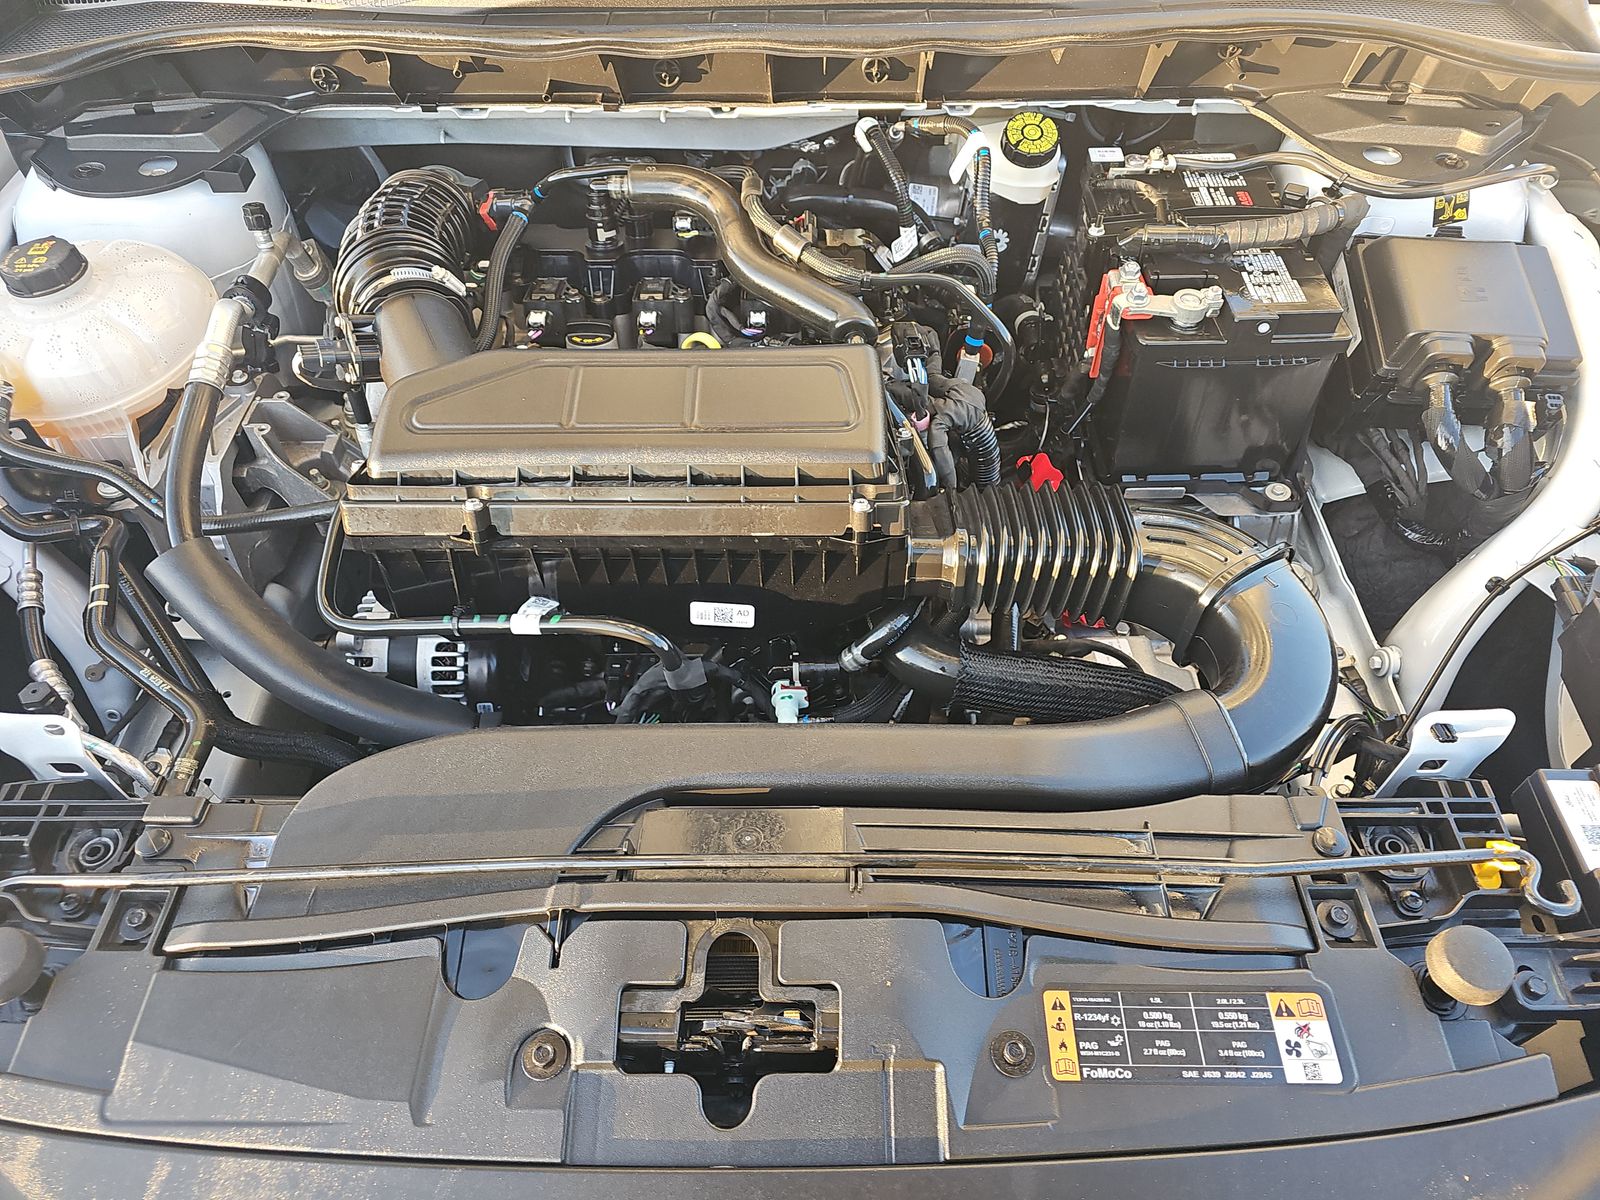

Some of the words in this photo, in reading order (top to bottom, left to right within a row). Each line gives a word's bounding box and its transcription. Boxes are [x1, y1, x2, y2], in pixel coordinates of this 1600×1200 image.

[1074, 1012, 1110, 1023] R-1234yf
[1142, 1012, 1162, 1020] 0.500
[1163, 1012, 1173, 1021] kg
[1218, 1012, 1237, 1020] 0.550
[1238, 1012, 1248, 1021] kg
[1079, 1041, 1099, 1050] PAG
[1082, 1068, 1132, 1079] FoMoCo
